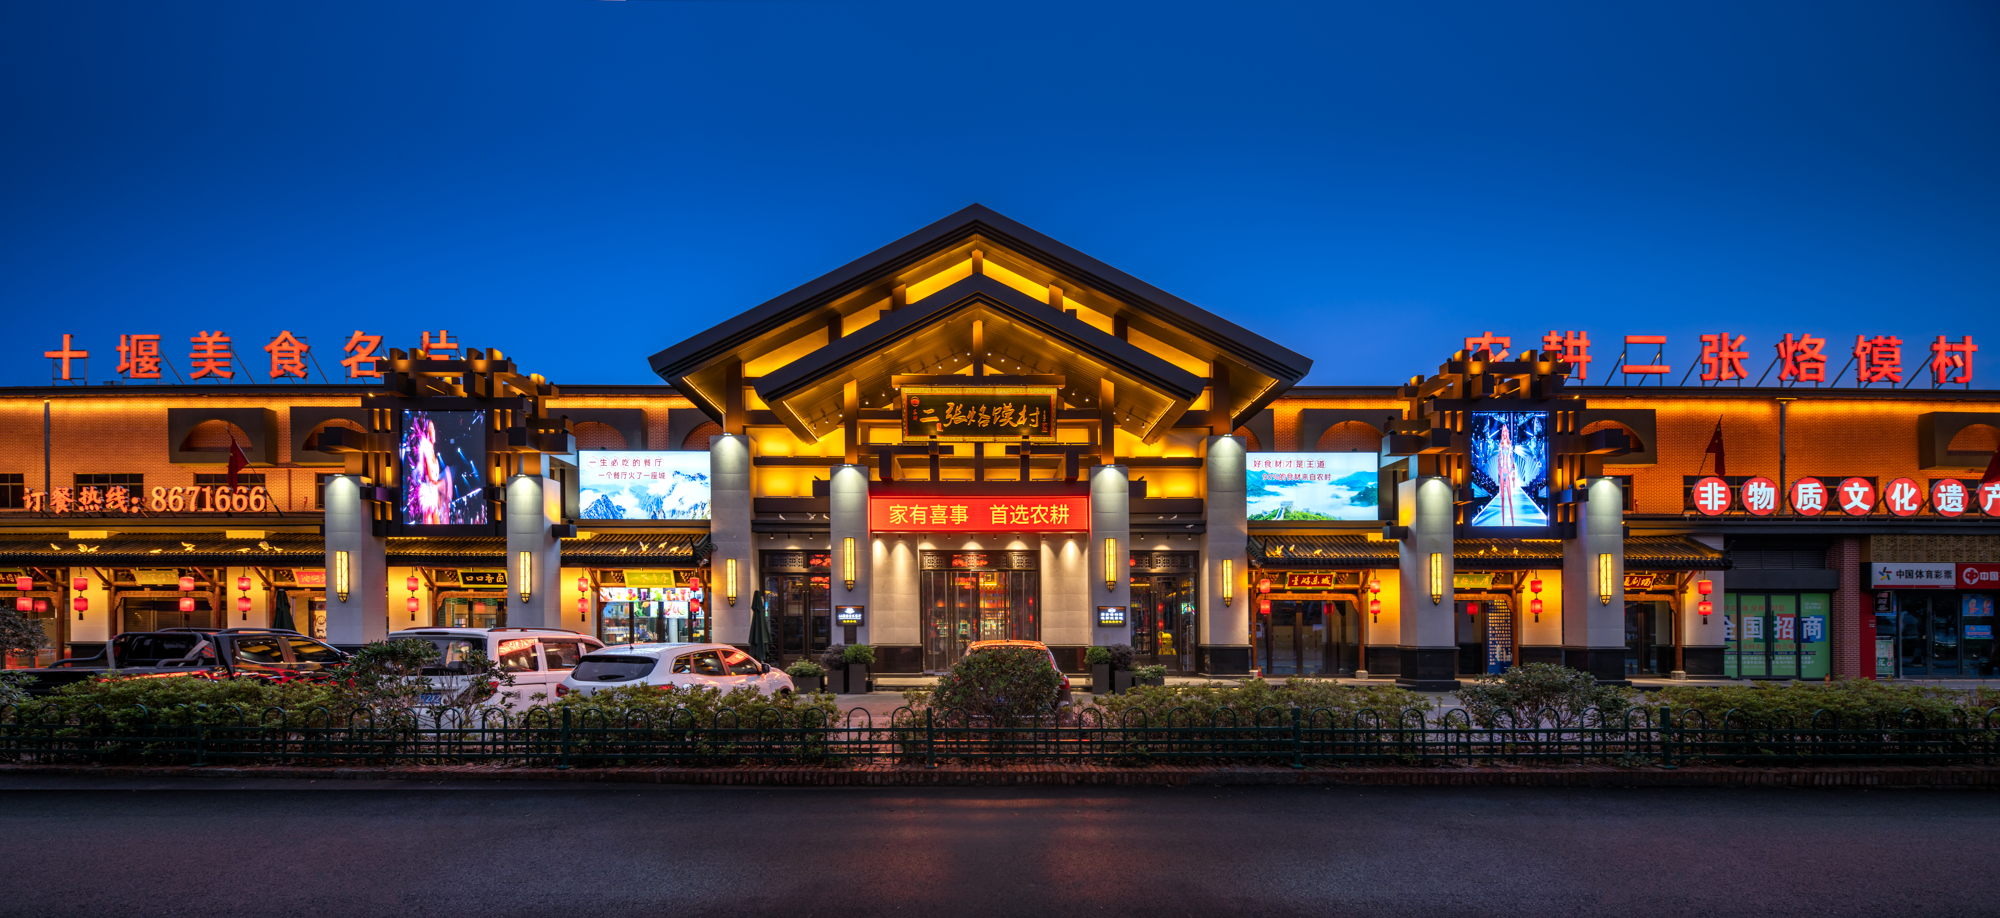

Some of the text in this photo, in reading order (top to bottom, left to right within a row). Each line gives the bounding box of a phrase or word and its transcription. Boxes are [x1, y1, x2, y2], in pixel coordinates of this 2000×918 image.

[44, 330, 458, 380] 十堰美食名片
[1465, 331, 1978, 383] 农耕二张烙馍村
[919, 402, 1040, 427] 二张烙馍村
[589, 458, 662, 467] 一生必吃的餐厅
[1253, 460, 1326, 469] 好食材才是王道
[598, 471, 666, 480] 一个餐厅火了一座城
[1262, 473, 1332, 481] 90%的食材来自农村
[1698, 482, 2000, 512] 非物质文化遗产
[889, 504, 1069, 525] 家有喜事 首选农耕
[1896, 569, 1953, 580] 中国体育彩票
[1980, 571, 2000, 581] 中国
[1724, 616, 1822, 640] 全国招商
